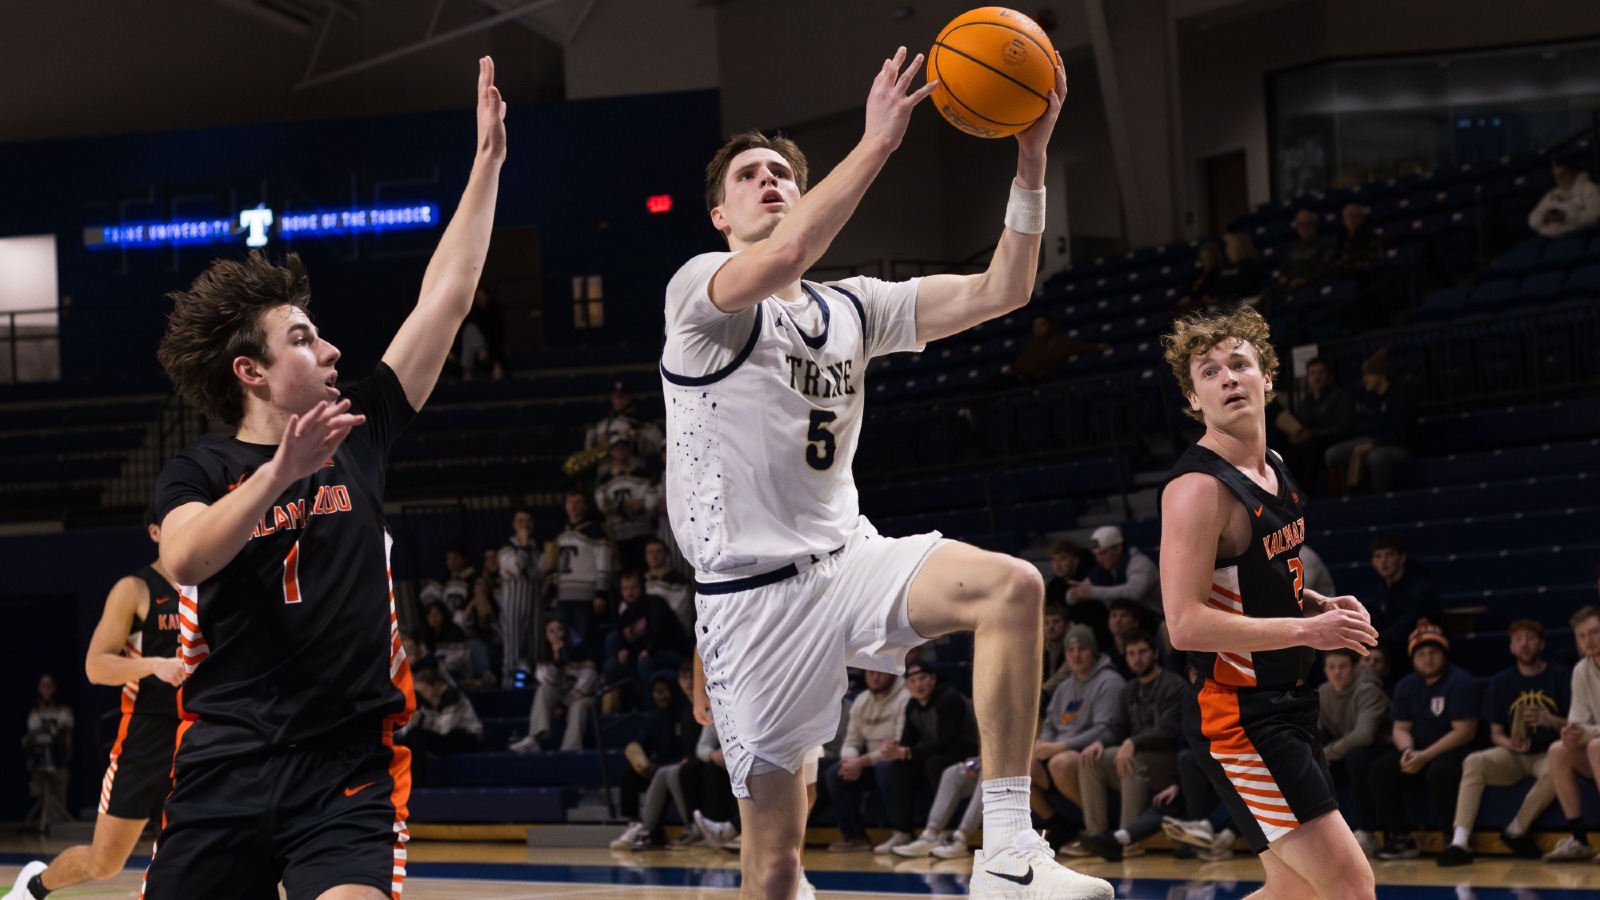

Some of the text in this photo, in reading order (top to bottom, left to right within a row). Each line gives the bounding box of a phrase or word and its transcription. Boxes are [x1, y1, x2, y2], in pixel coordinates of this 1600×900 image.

[239, 208, 273, 247] T
[785, 354, 856, 398] TRINE
[805, 408, 837, 471] 5
[283, 539, 302, 604] 1
